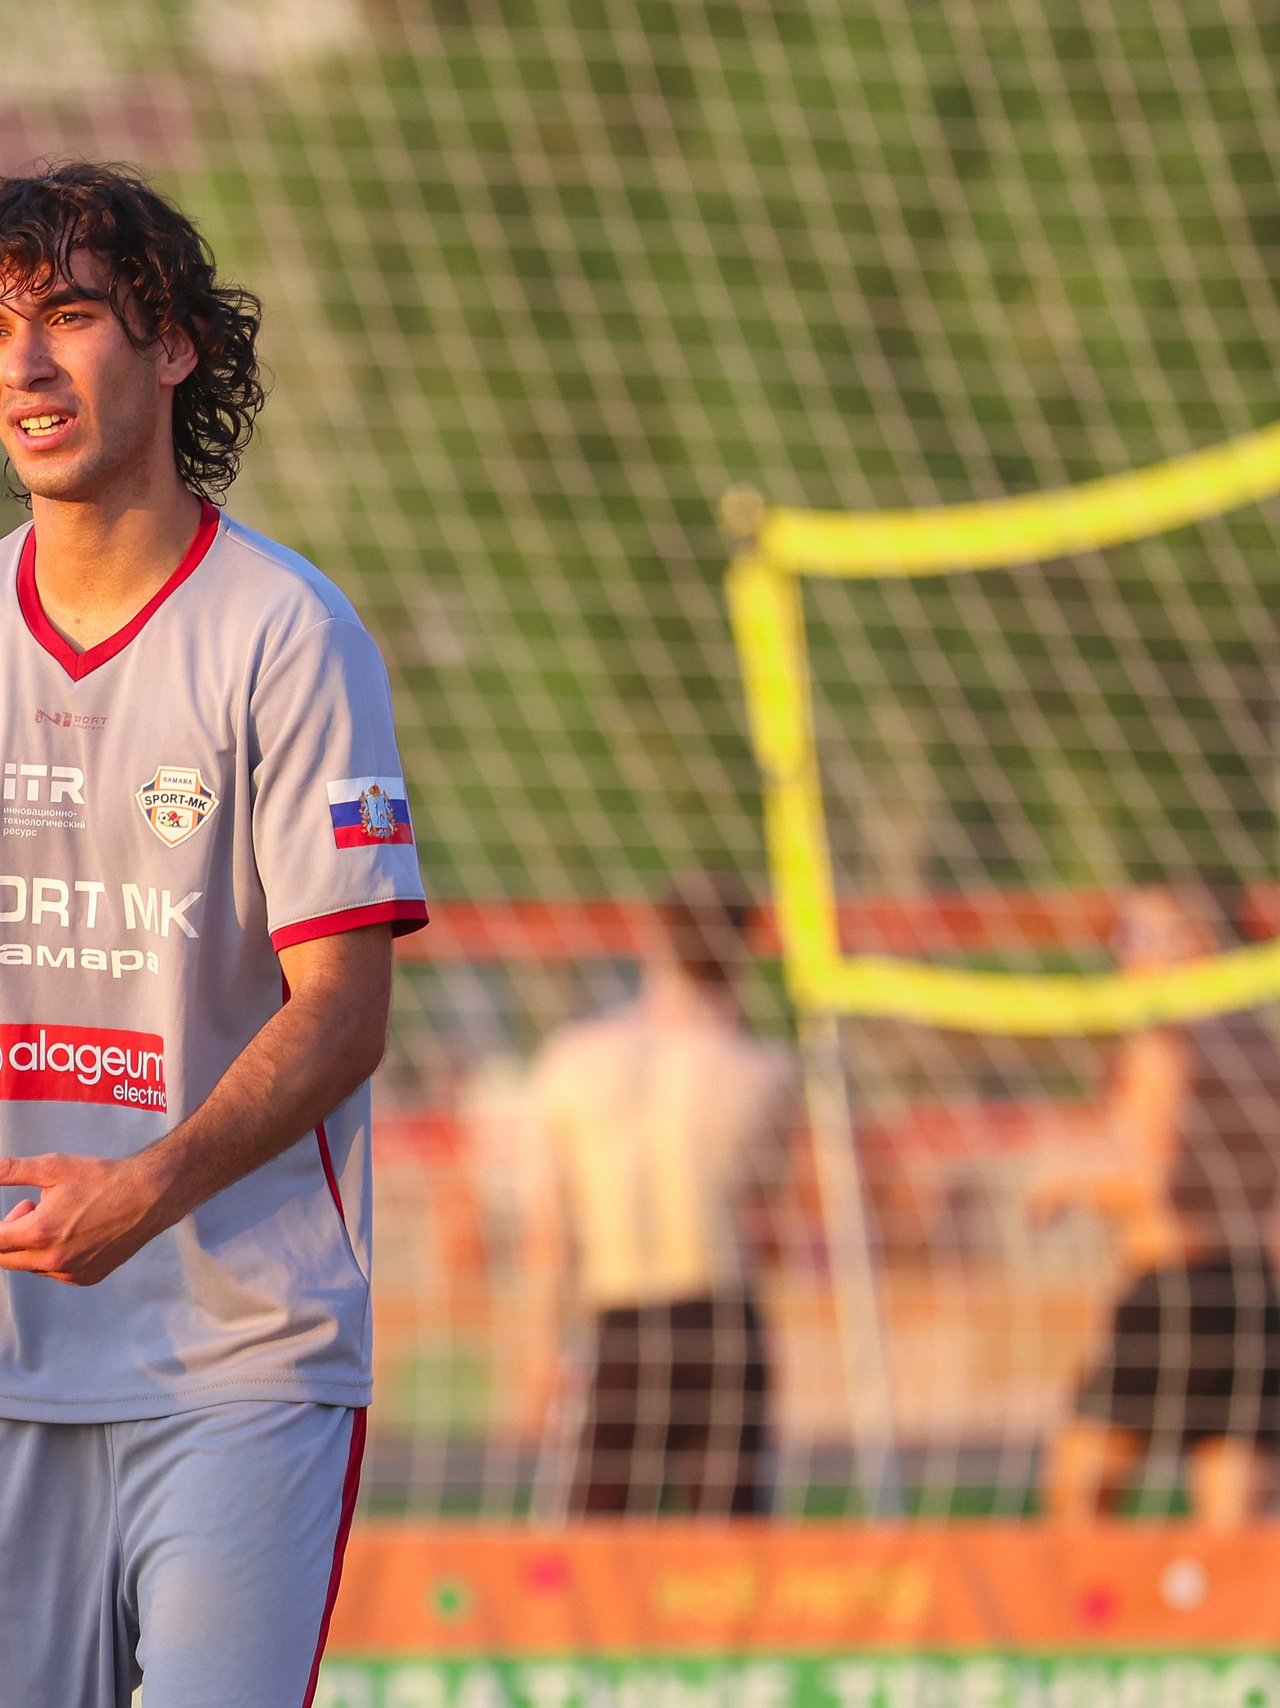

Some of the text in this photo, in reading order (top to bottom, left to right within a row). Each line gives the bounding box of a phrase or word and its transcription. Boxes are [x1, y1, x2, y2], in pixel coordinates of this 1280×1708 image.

[162, 776, 193, 785] SAMARA
[144, 793, 208, 811] SPORT-MK
[3, 807, 78, 818] инновационно-
[3, 817, 86, 829] технологический
[3, 828, 38, 838] ресурс
[121, 883, 203, 939] MK
[8, 1029, 165, 1085] alageum
[113, 1080, 167, 1107] electric
